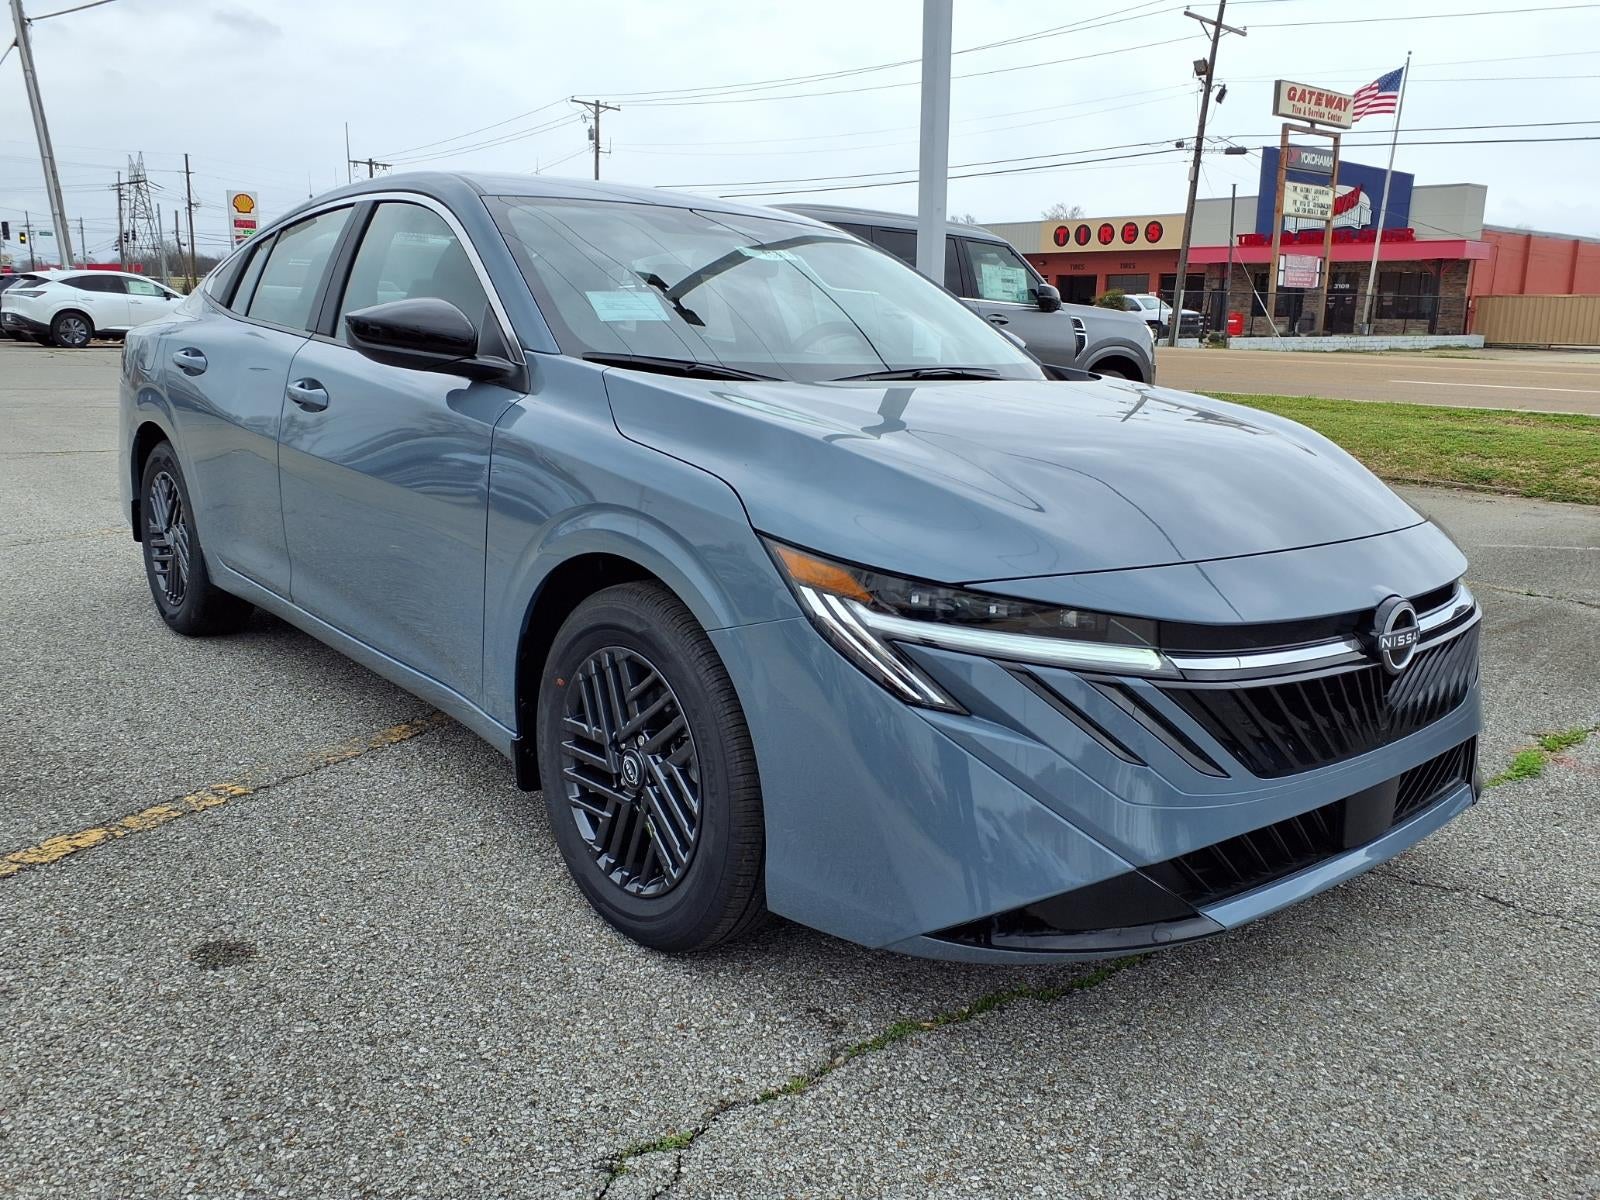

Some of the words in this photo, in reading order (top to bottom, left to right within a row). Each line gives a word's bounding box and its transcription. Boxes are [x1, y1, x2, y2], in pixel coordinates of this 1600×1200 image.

[1287, 86, 1352, 112] GATEWAY
[1292, 104, 1301, 115] Tire
[1308, 107, 1325, 119] Service
[1327, 111, 1342, 122] Center
[1300, 152, 1333, 168] YOKOHAMA
[1056, 222, 1161, 245] TIRES
[1070, 263, 1085, 271] TIRES
